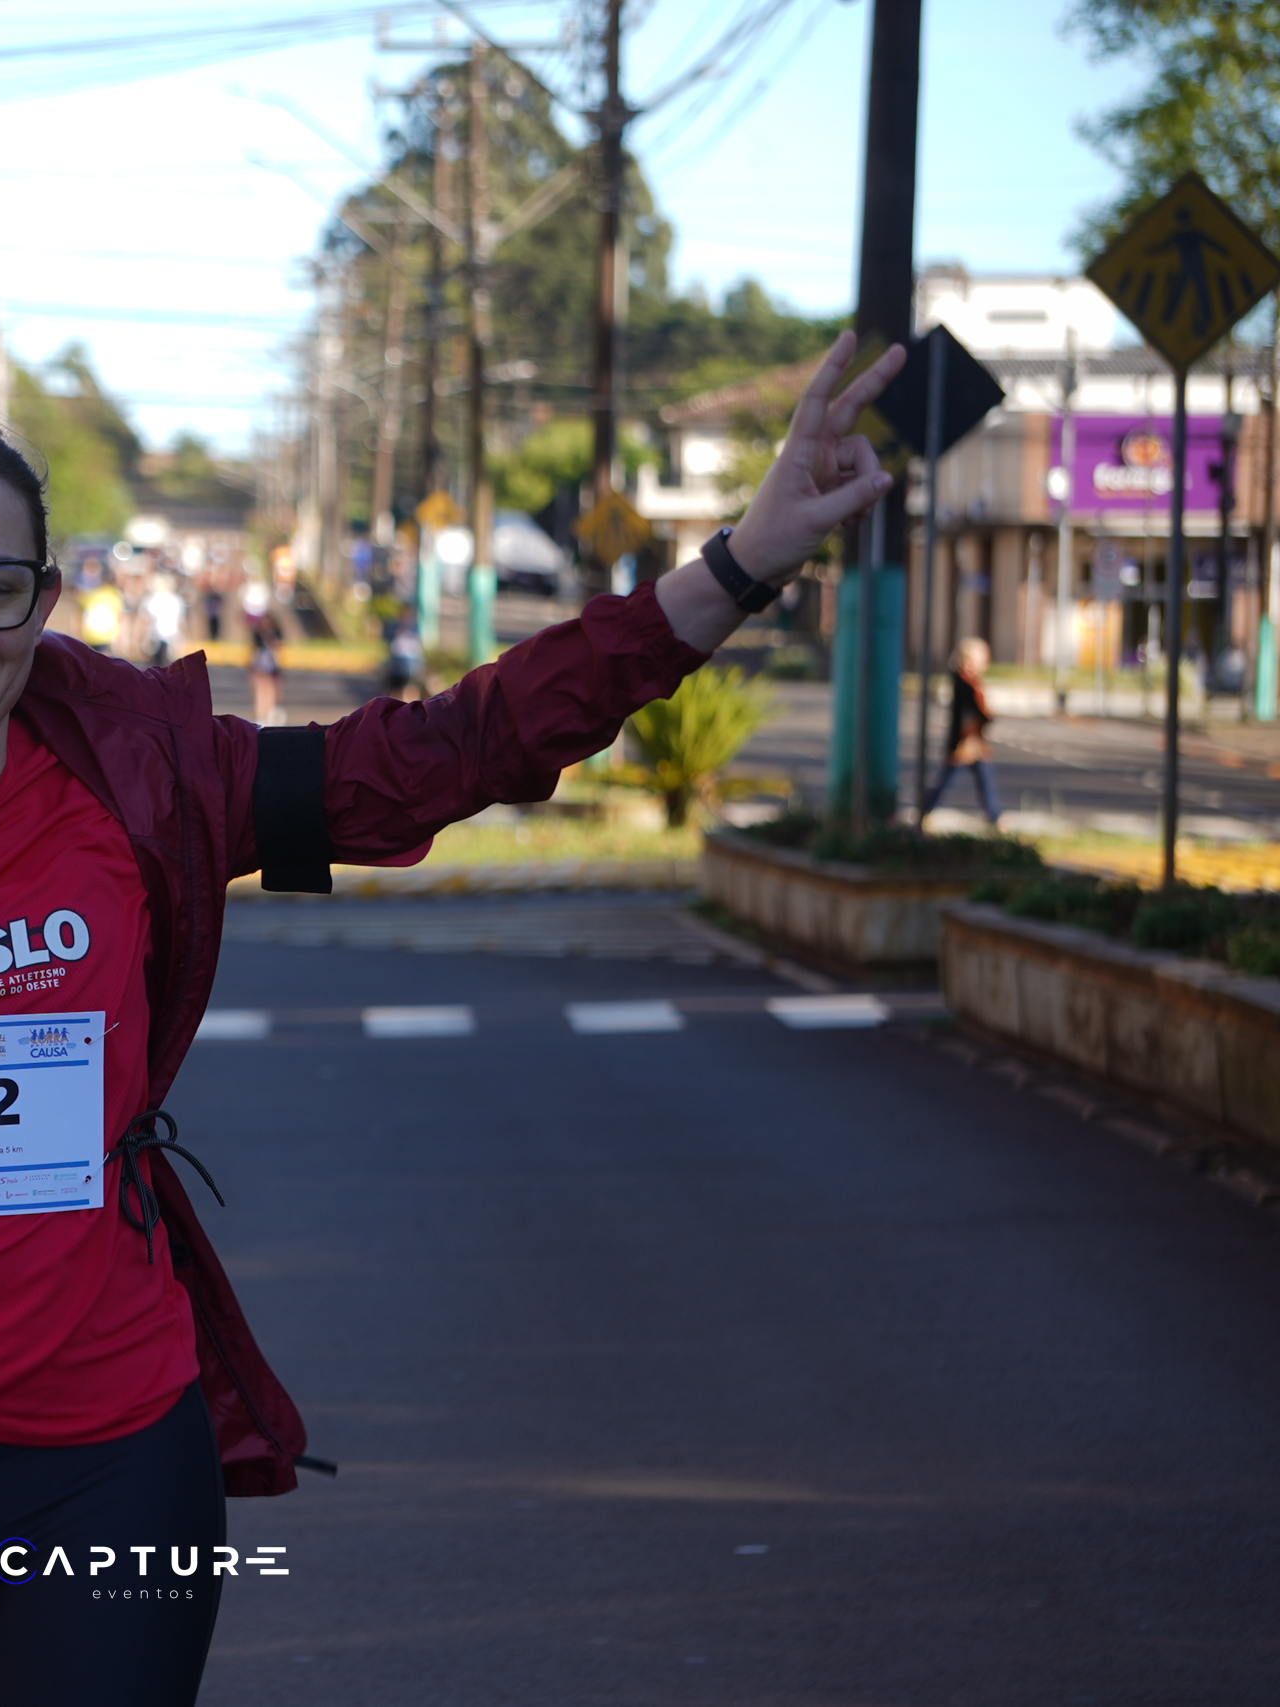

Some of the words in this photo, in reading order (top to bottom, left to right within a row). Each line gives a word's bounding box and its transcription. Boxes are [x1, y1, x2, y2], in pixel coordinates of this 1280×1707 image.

[9, 967, 66, 985] ATLETISMO
[10, 985, 23, 995] DO
[26, 979, 60, 992] OESTE
[30, 1046, 68, 1058] CAUSA
[12, 1145, 23, 1153] km
